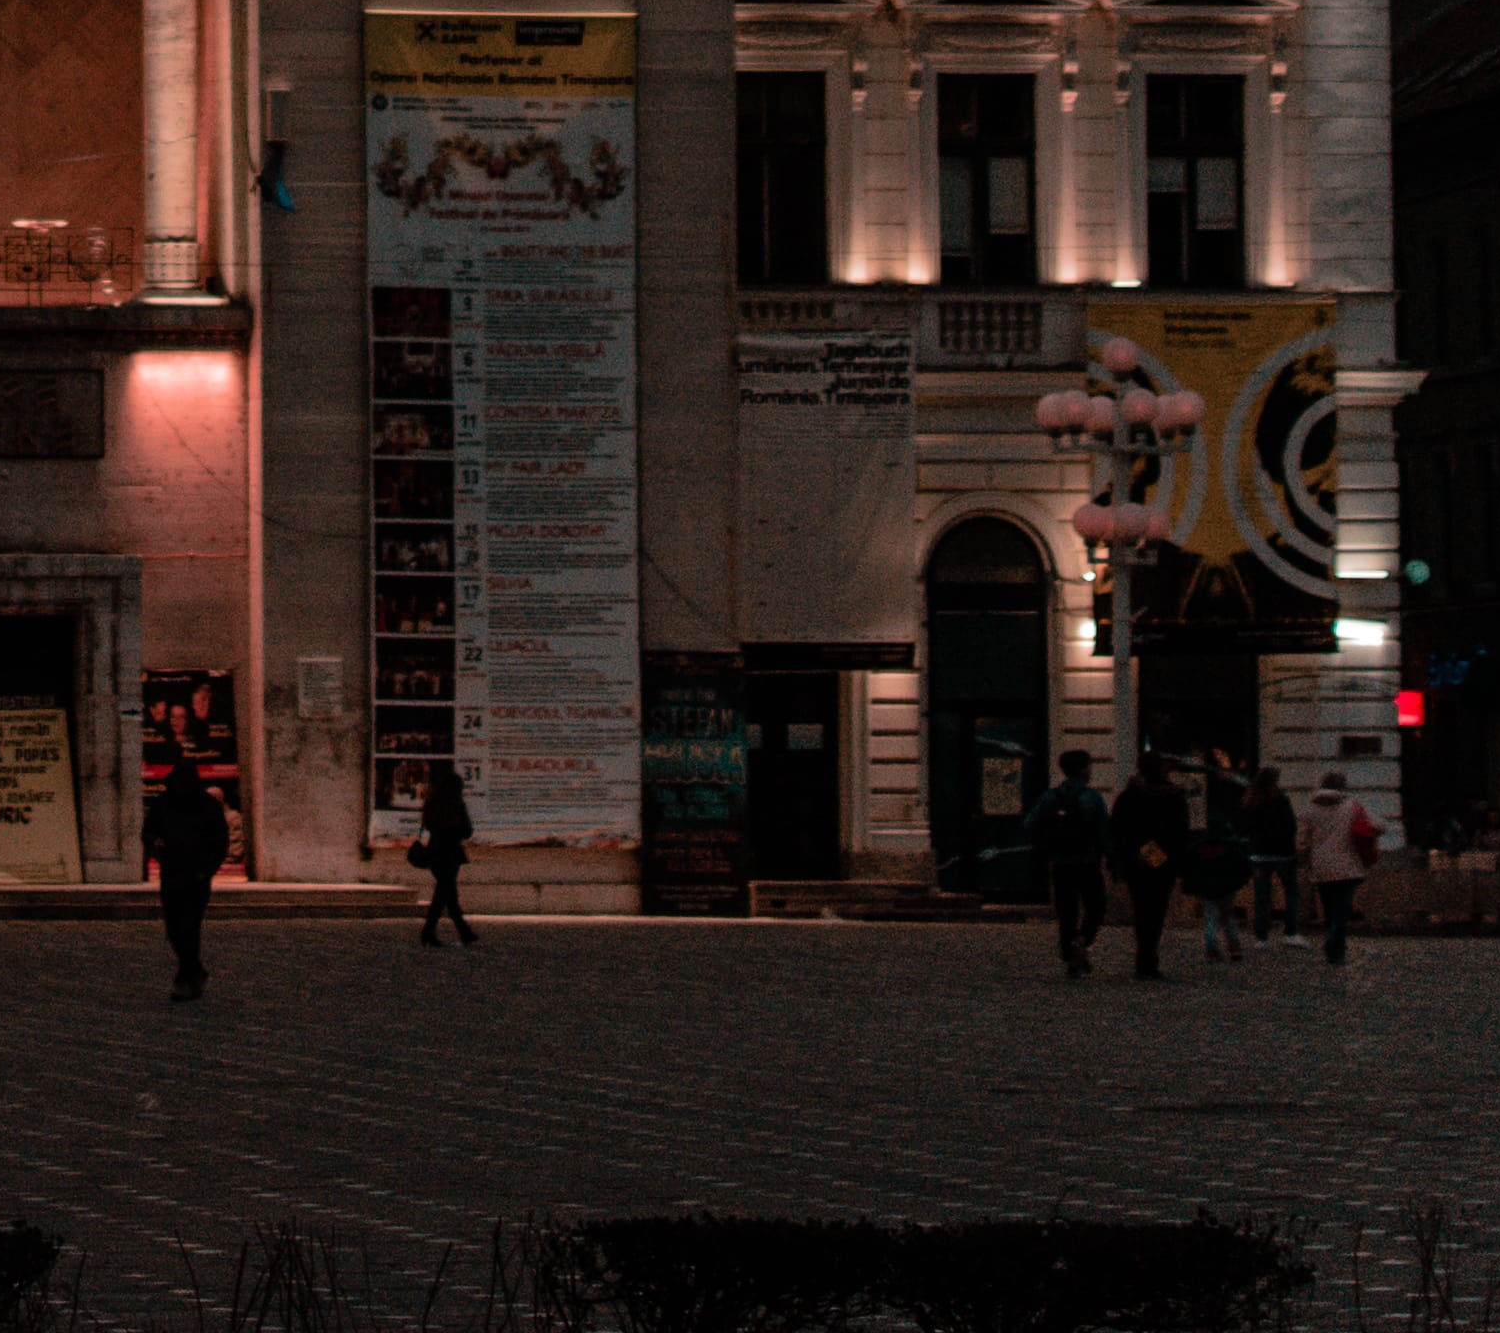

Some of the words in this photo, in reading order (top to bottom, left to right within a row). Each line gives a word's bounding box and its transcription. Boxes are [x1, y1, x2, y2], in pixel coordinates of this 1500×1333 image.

[460, 415, 477, 429] 11
[464, 646, 482, 662] 22
[463, 714, 482, 729] 24
[463, 766, 481, 781] 31
